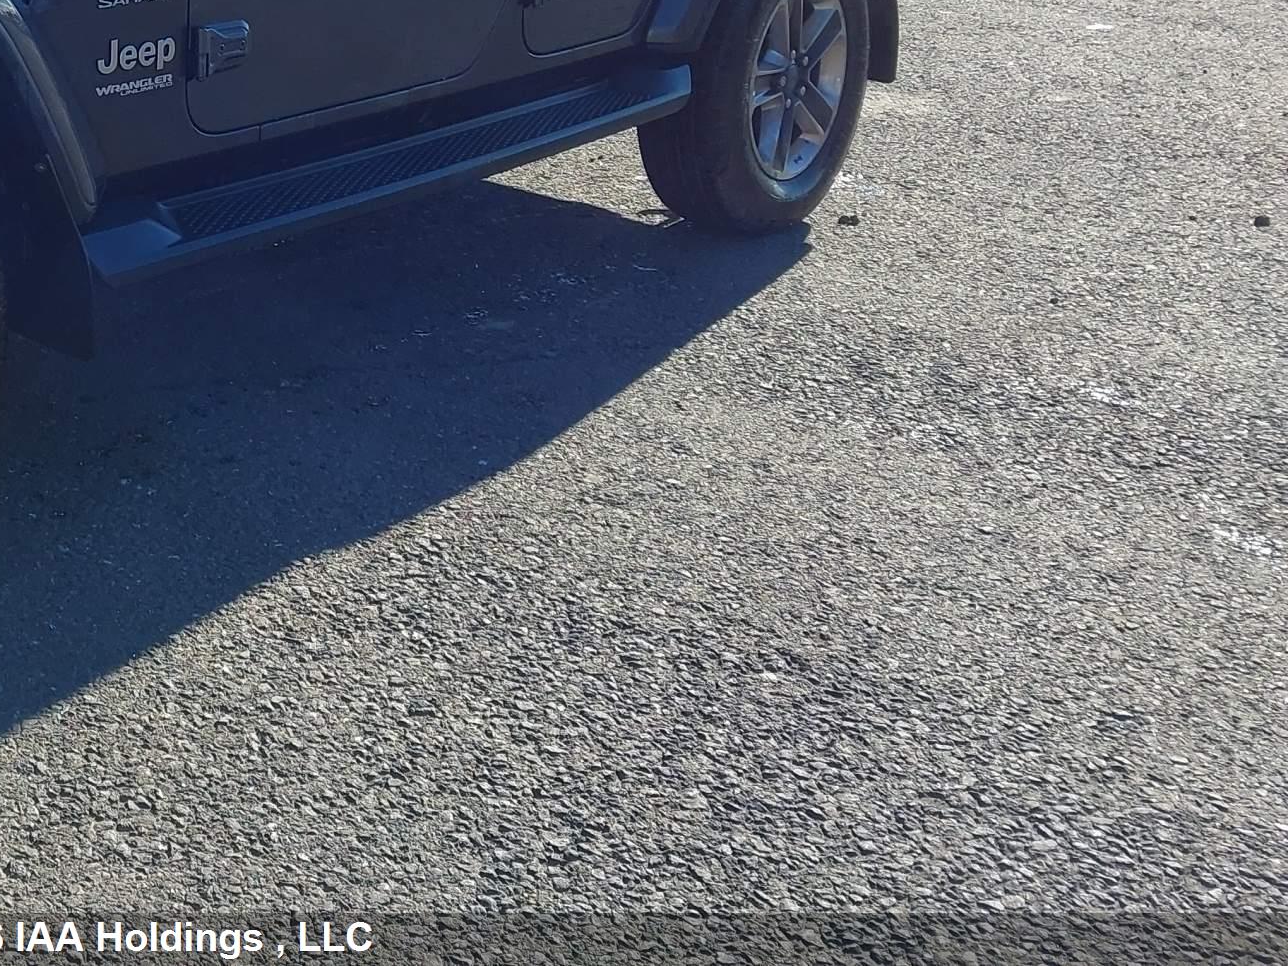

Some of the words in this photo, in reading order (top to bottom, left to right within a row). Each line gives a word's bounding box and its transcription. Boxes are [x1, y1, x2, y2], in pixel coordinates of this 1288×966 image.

[97, 37, 176, 75] Jeep
[95, 73, 173, 97] WRANGLER
[120, 81, 173, 96] UNLIMITED
